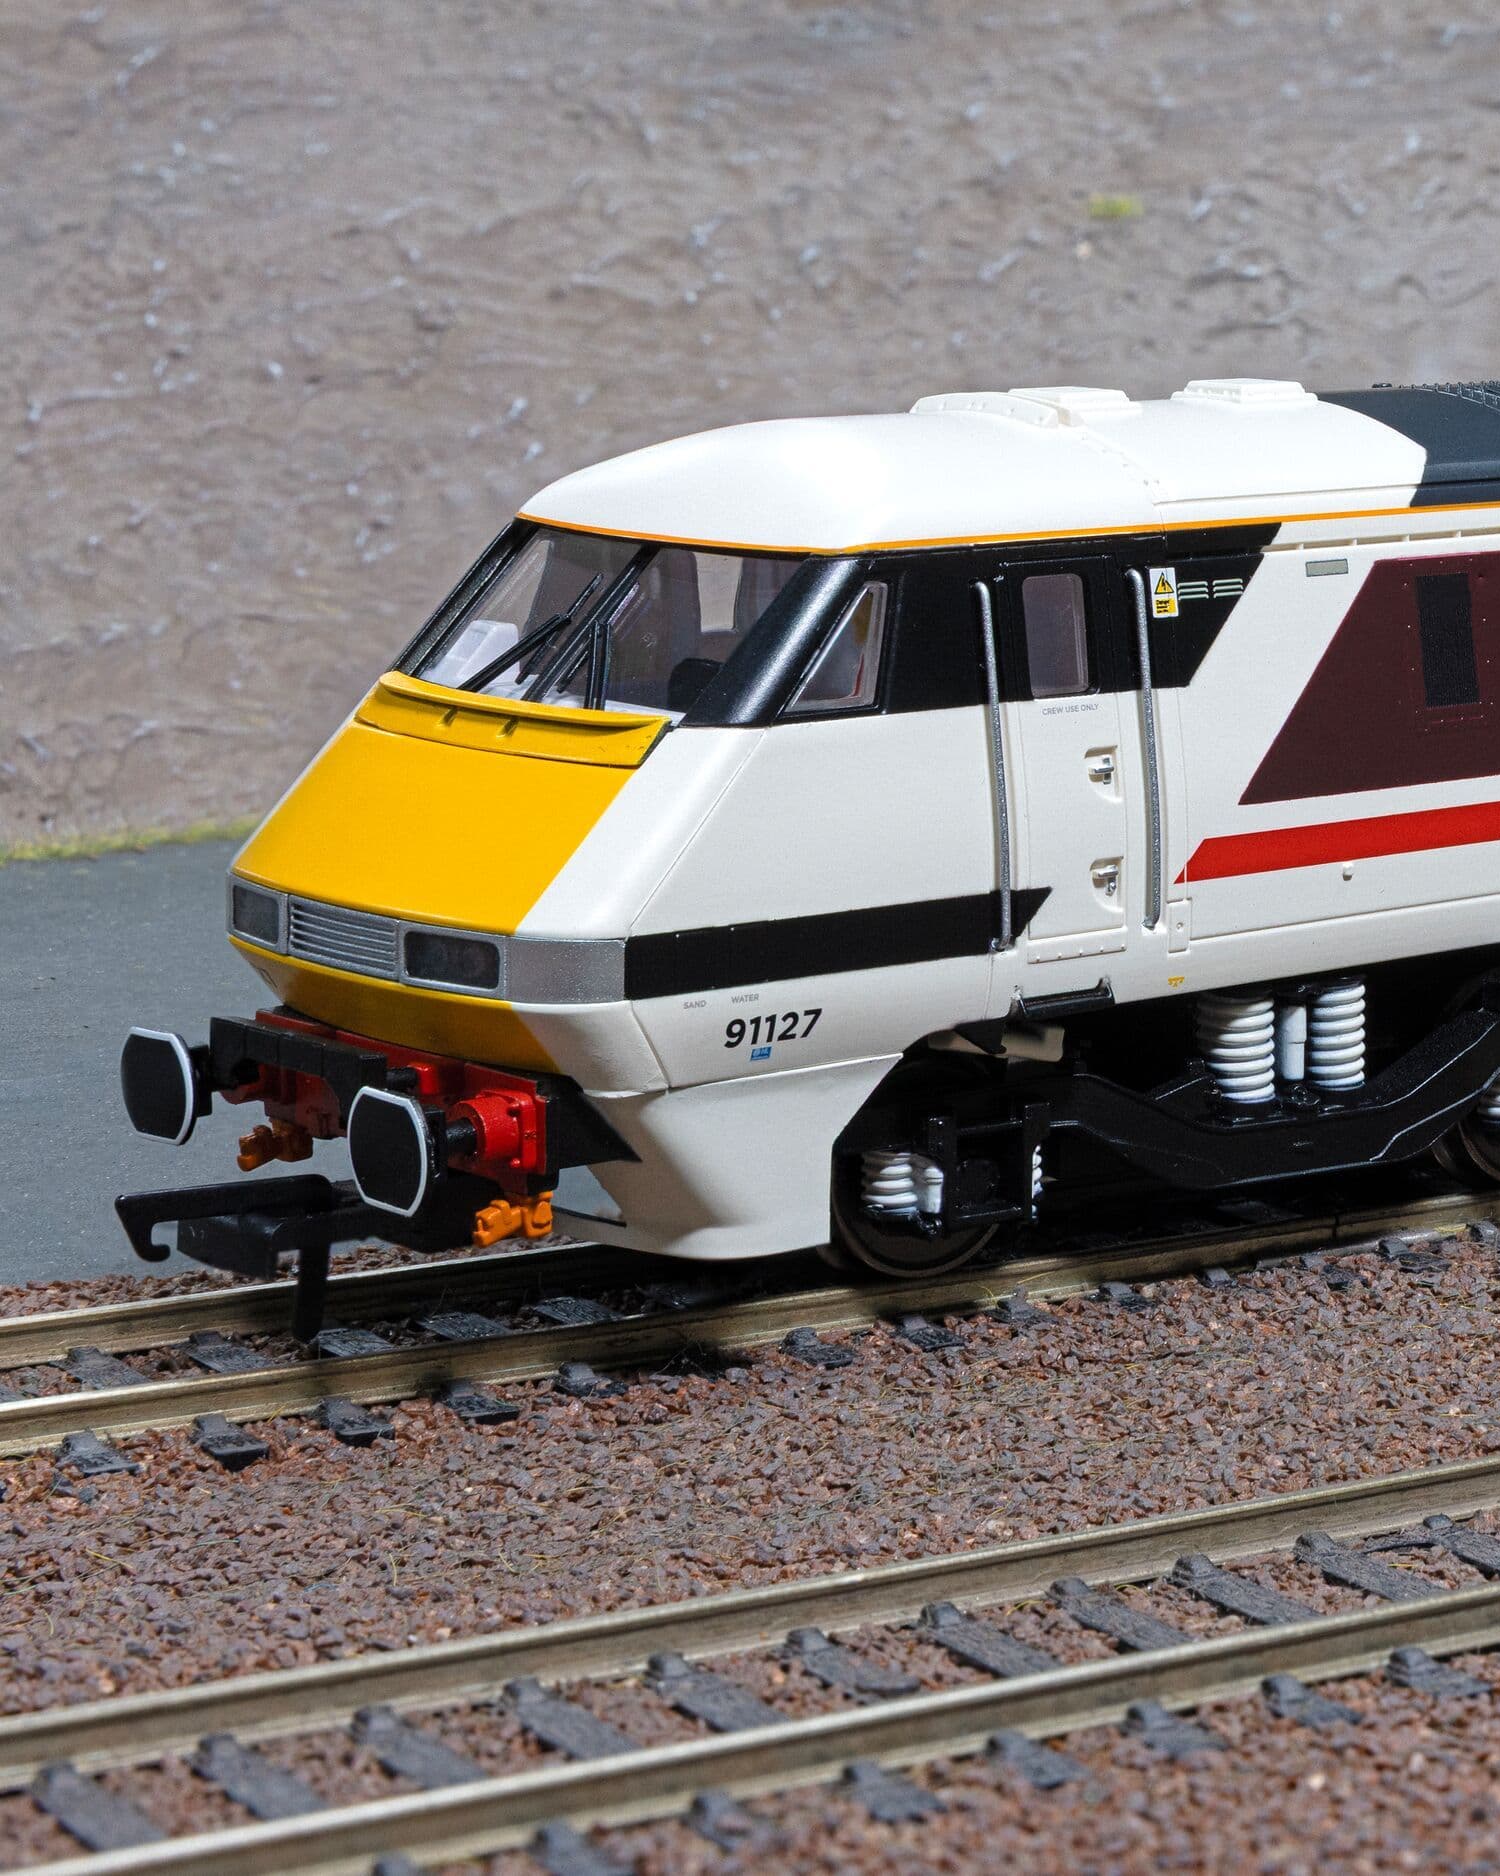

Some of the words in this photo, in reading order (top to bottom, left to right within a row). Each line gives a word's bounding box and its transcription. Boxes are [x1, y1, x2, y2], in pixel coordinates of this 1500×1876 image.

[1042, 706, 1064, 715] CREW
[1065, 705, 1080, 713] USE
[1081, 703, 1099, 712] ONLY
[731, 993, 760, 1004] WATER
[683, 1000, 706, 1009] SAND
[724, 1008, 823, 1049] 91127
